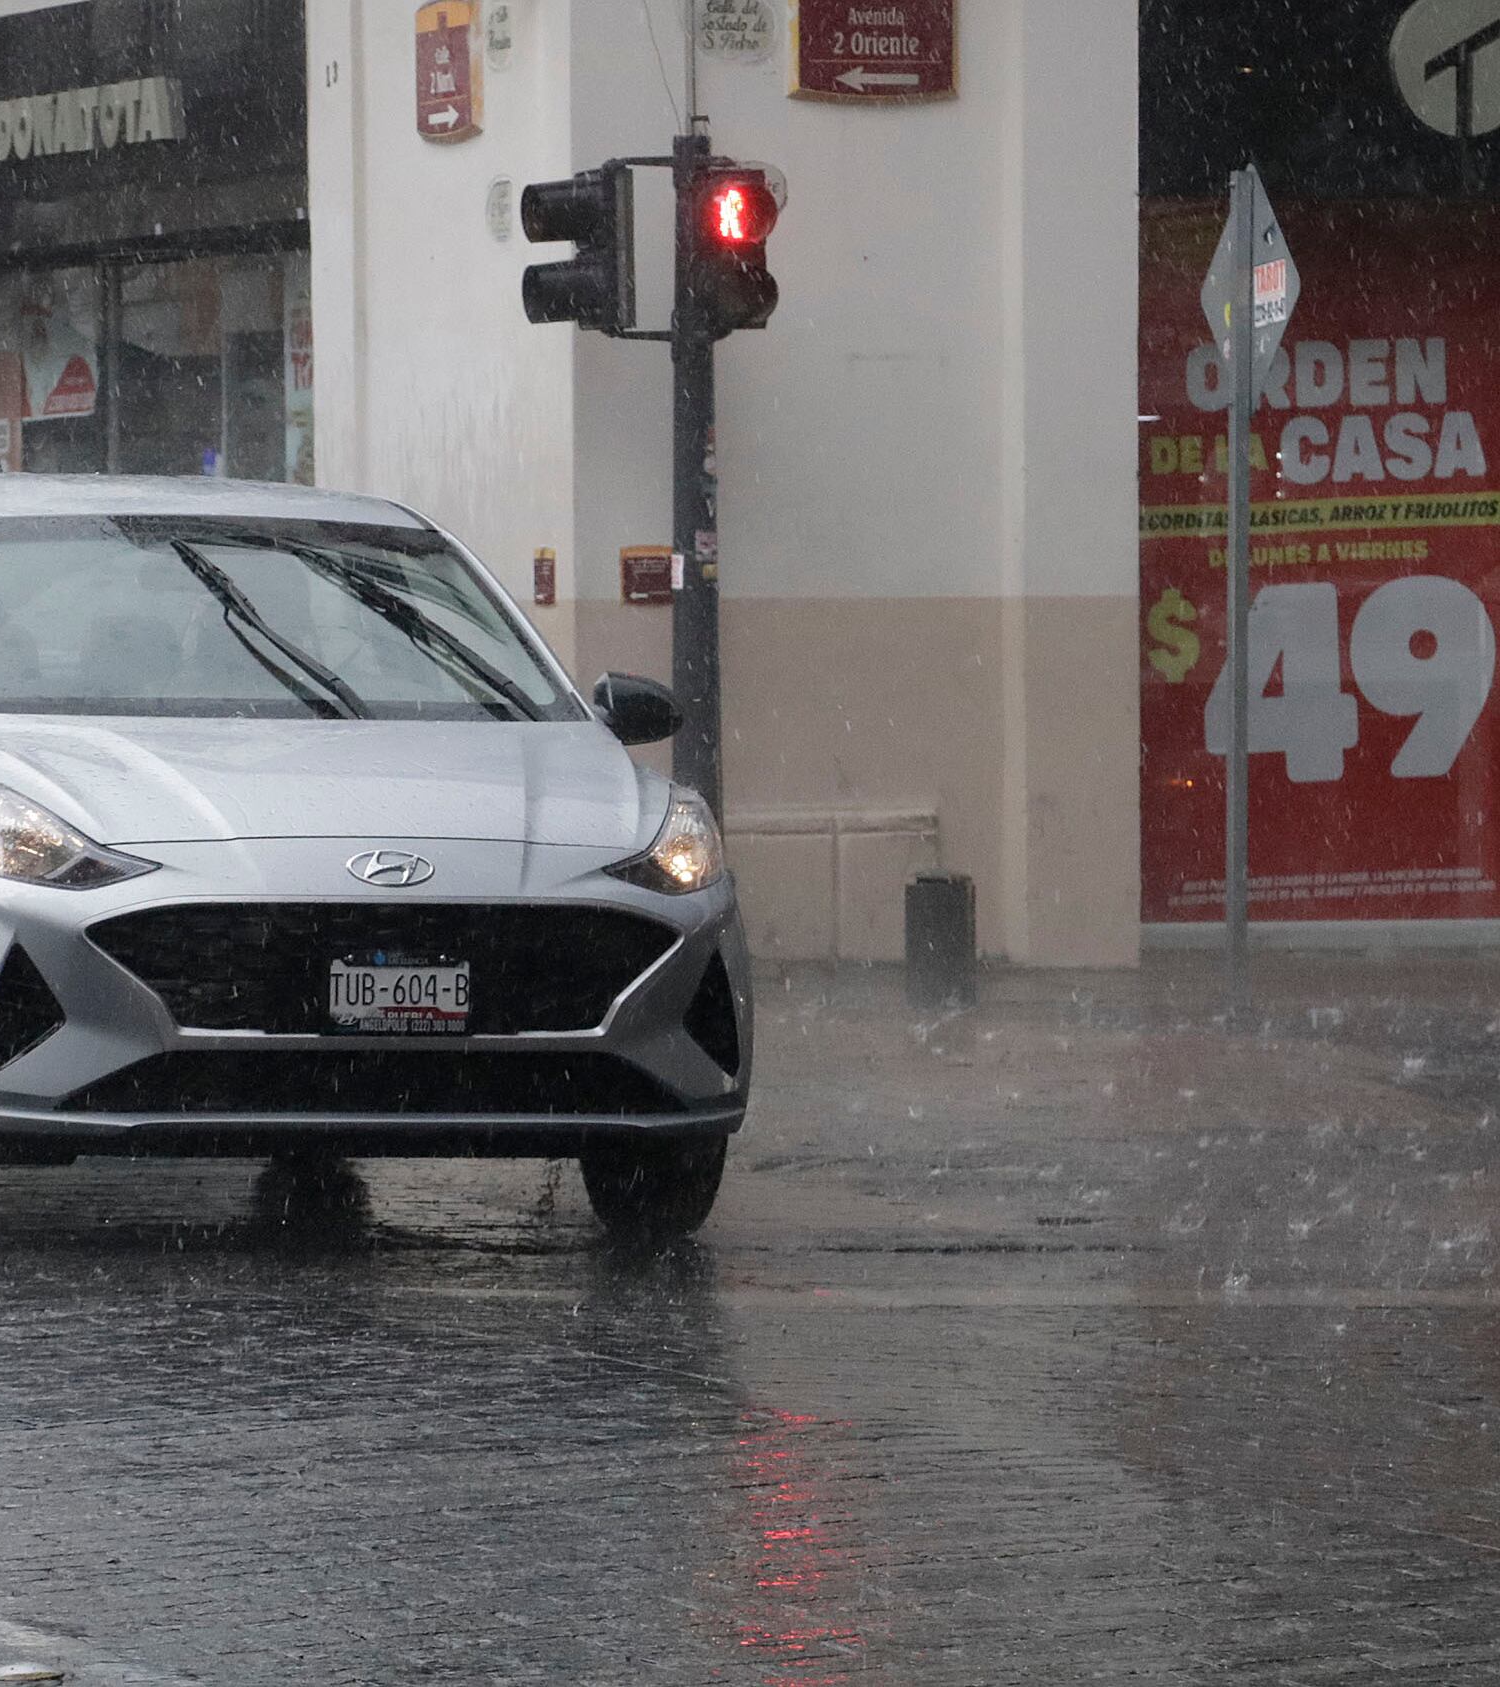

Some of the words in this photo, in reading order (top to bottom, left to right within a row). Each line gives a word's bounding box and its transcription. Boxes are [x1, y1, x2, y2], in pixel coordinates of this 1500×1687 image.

[850, 7, 905, 26] Avenida
[833, 33, 845, 54] 2
[850, 31, 920, 56] Oriente
[1151, 434, 1203, 475] DE
[1280, 411, 1488, 485] CASA
[1317, 543, 1332, 562] A
[1336, 539, 1430, 561] VIERNES
[331, 973, 468, 1007] TUB-604-B
